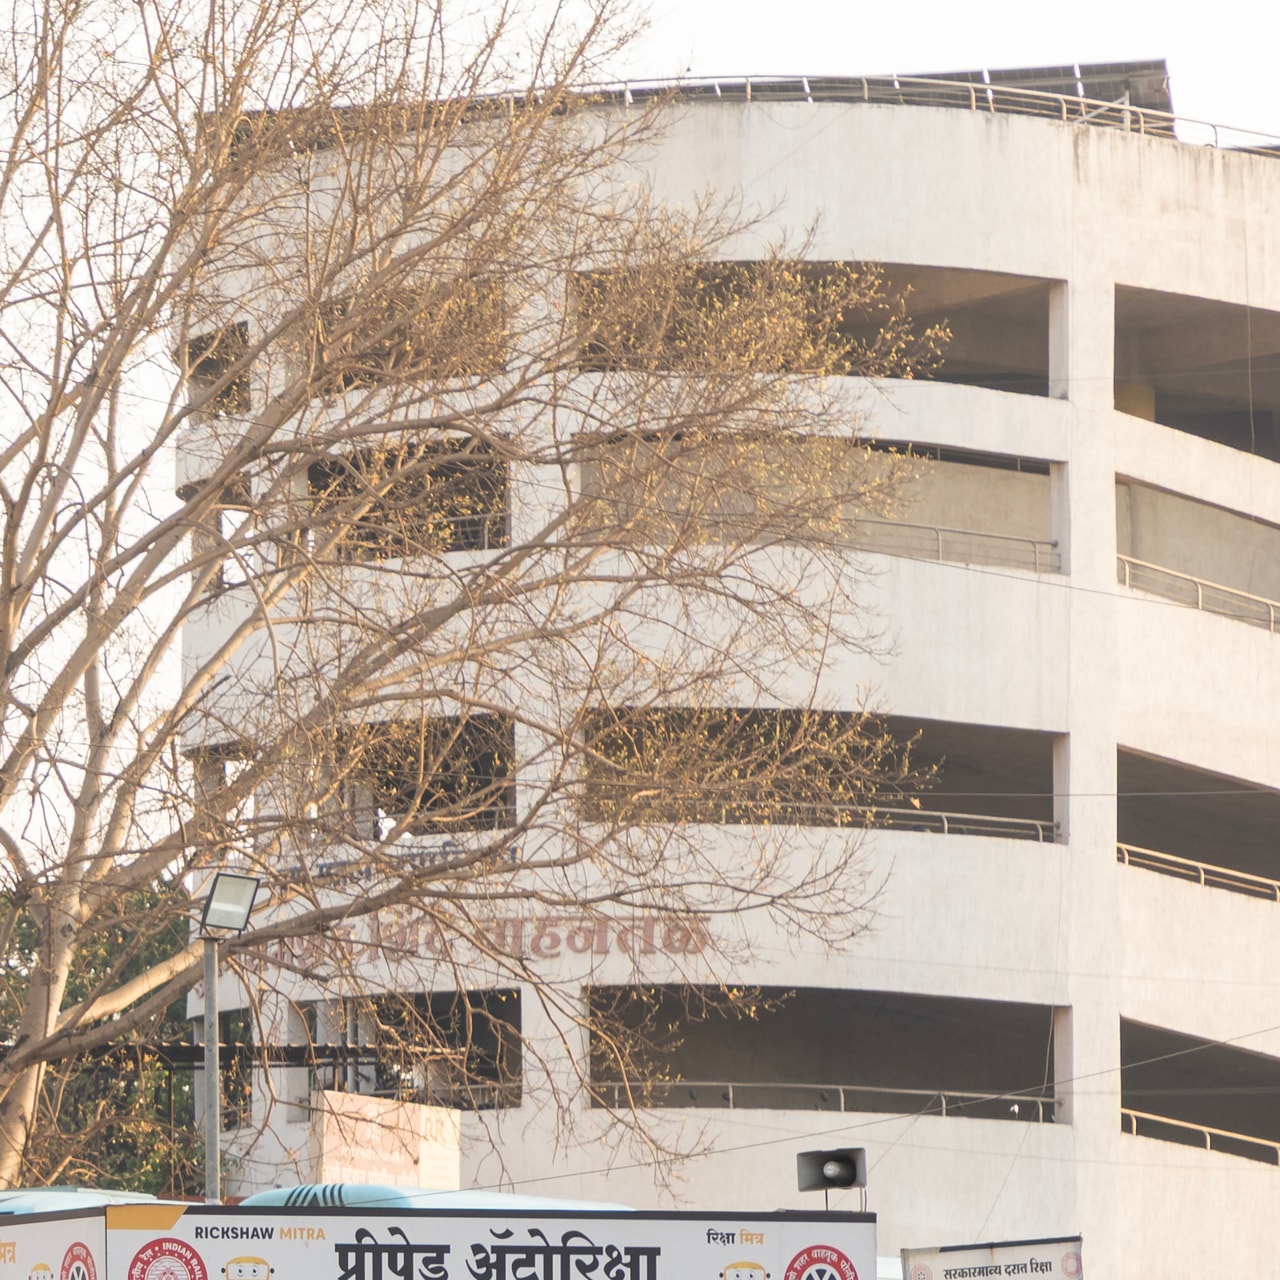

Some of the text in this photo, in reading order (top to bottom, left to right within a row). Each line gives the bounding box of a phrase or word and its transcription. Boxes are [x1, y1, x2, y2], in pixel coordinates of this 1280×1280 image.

[195, 1226, 326, 1241] RICKSHAW MITRA
[706, 1228, 765, 1246] रिक्षा मित्र
[162, 1242, 192, 1260] INDIAN
[1004, 1262, 1027, 1276] दरात
[1030, 1257, 1053, 1274] रिक्षा
